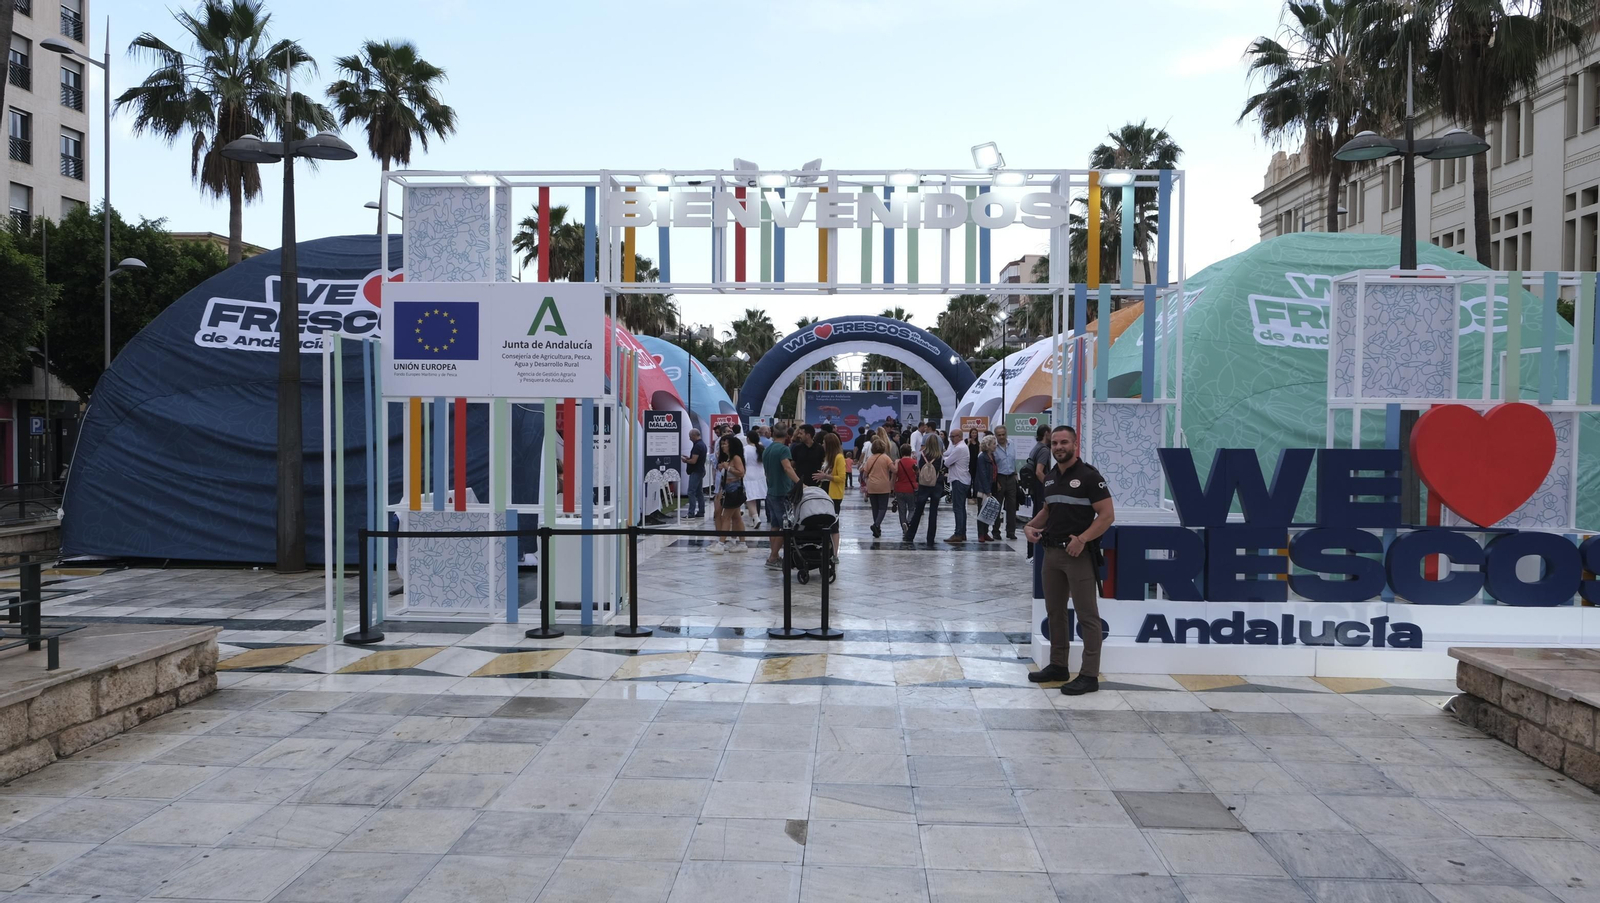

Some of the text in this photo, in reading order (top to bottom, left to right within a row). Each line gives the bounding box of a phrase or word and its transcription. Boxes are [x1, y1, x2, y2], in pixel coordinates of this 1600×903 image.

[609, 191, 1066, 229] BIENVENIDOS
[272, 279, 359, 305] WE
[202, 332, 227, 343] de
[502, 339, 593, 350] Junta de Andalucía
[784, 333, 816, 352] WE
[832, 322, 910, 338] FRESCOS
[1260, 330, 1285, 340] de
[394, 362, 419, 370] UNIÓN
[1158, 448, 1402, 527] WE
[1135, 611, 1423, 648] Andalucía
